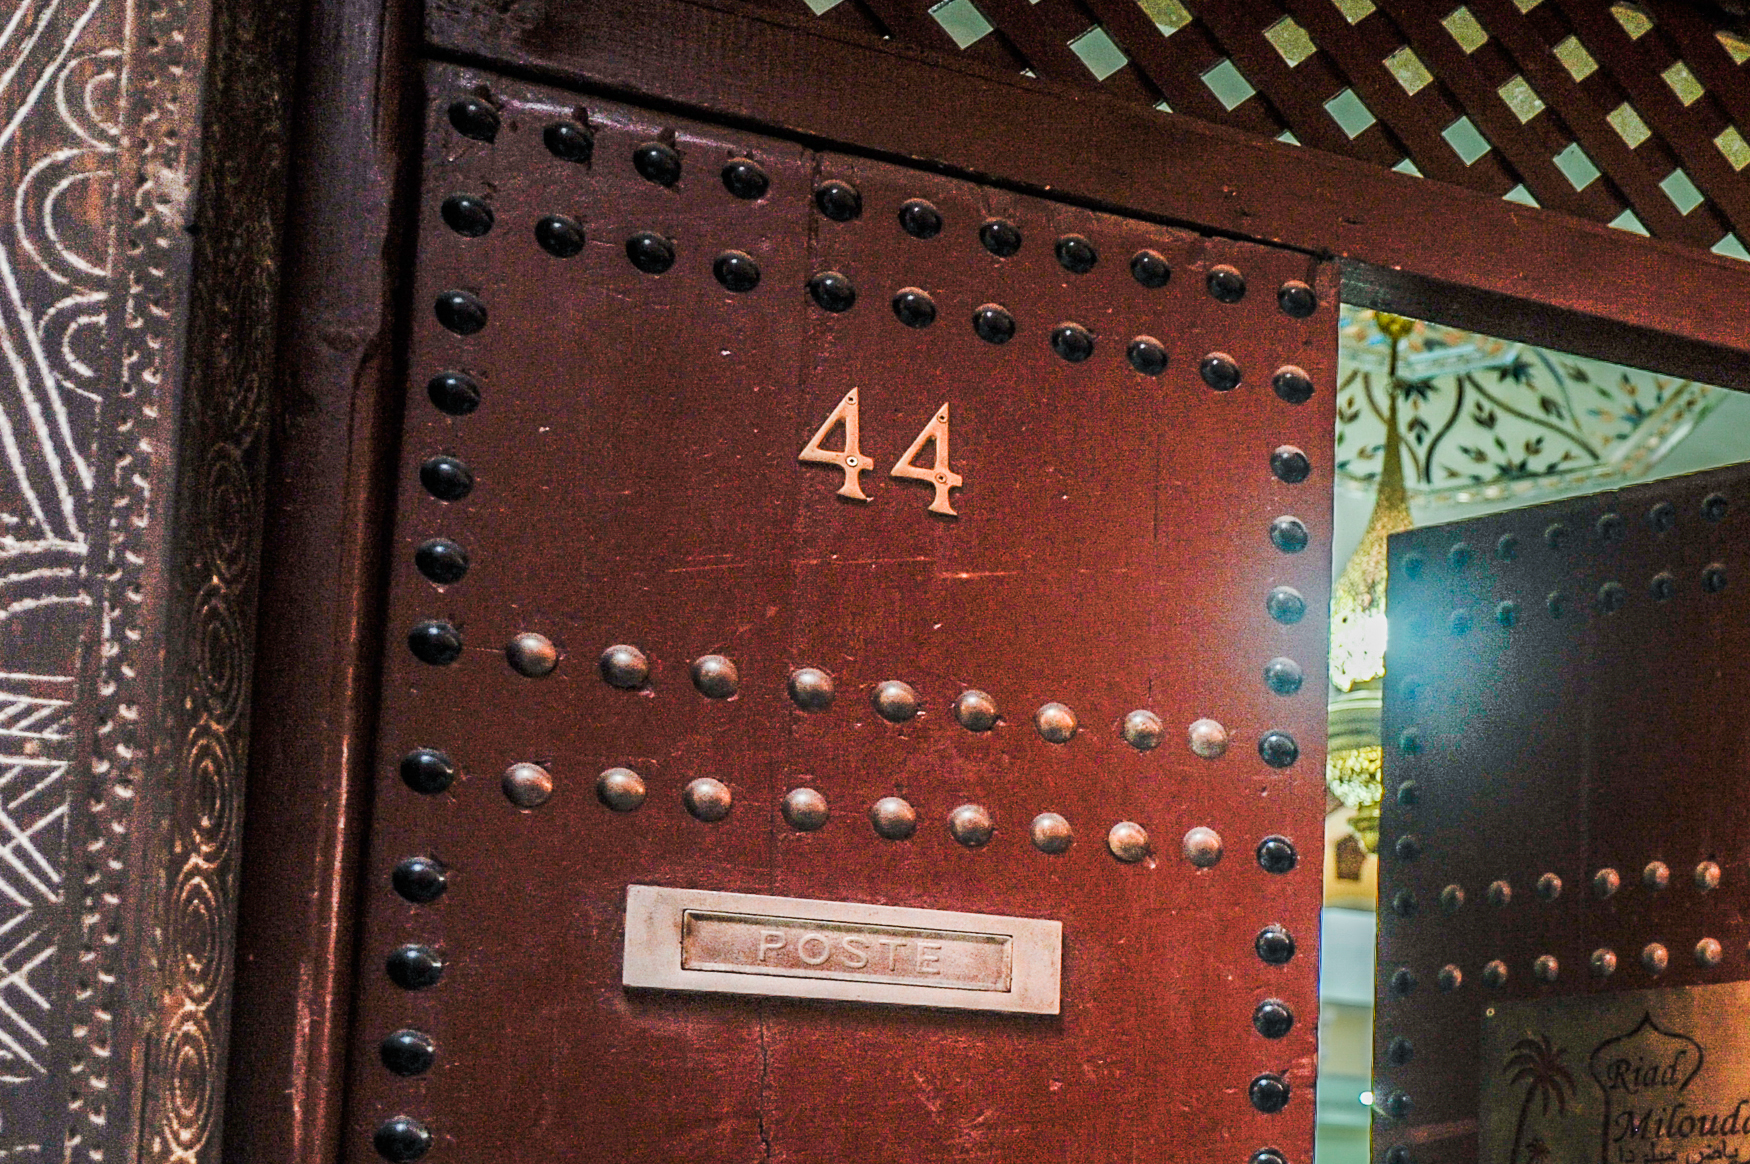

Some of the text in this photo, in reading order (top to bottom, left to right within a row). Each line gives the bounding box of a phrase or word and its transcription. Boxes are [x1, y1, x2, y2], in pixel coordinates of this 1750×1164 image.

[798, 386, 963, 516] 44
[758, 930, 942, 975] POSTE
[1606, 1050, 1688, 1095] Riad
